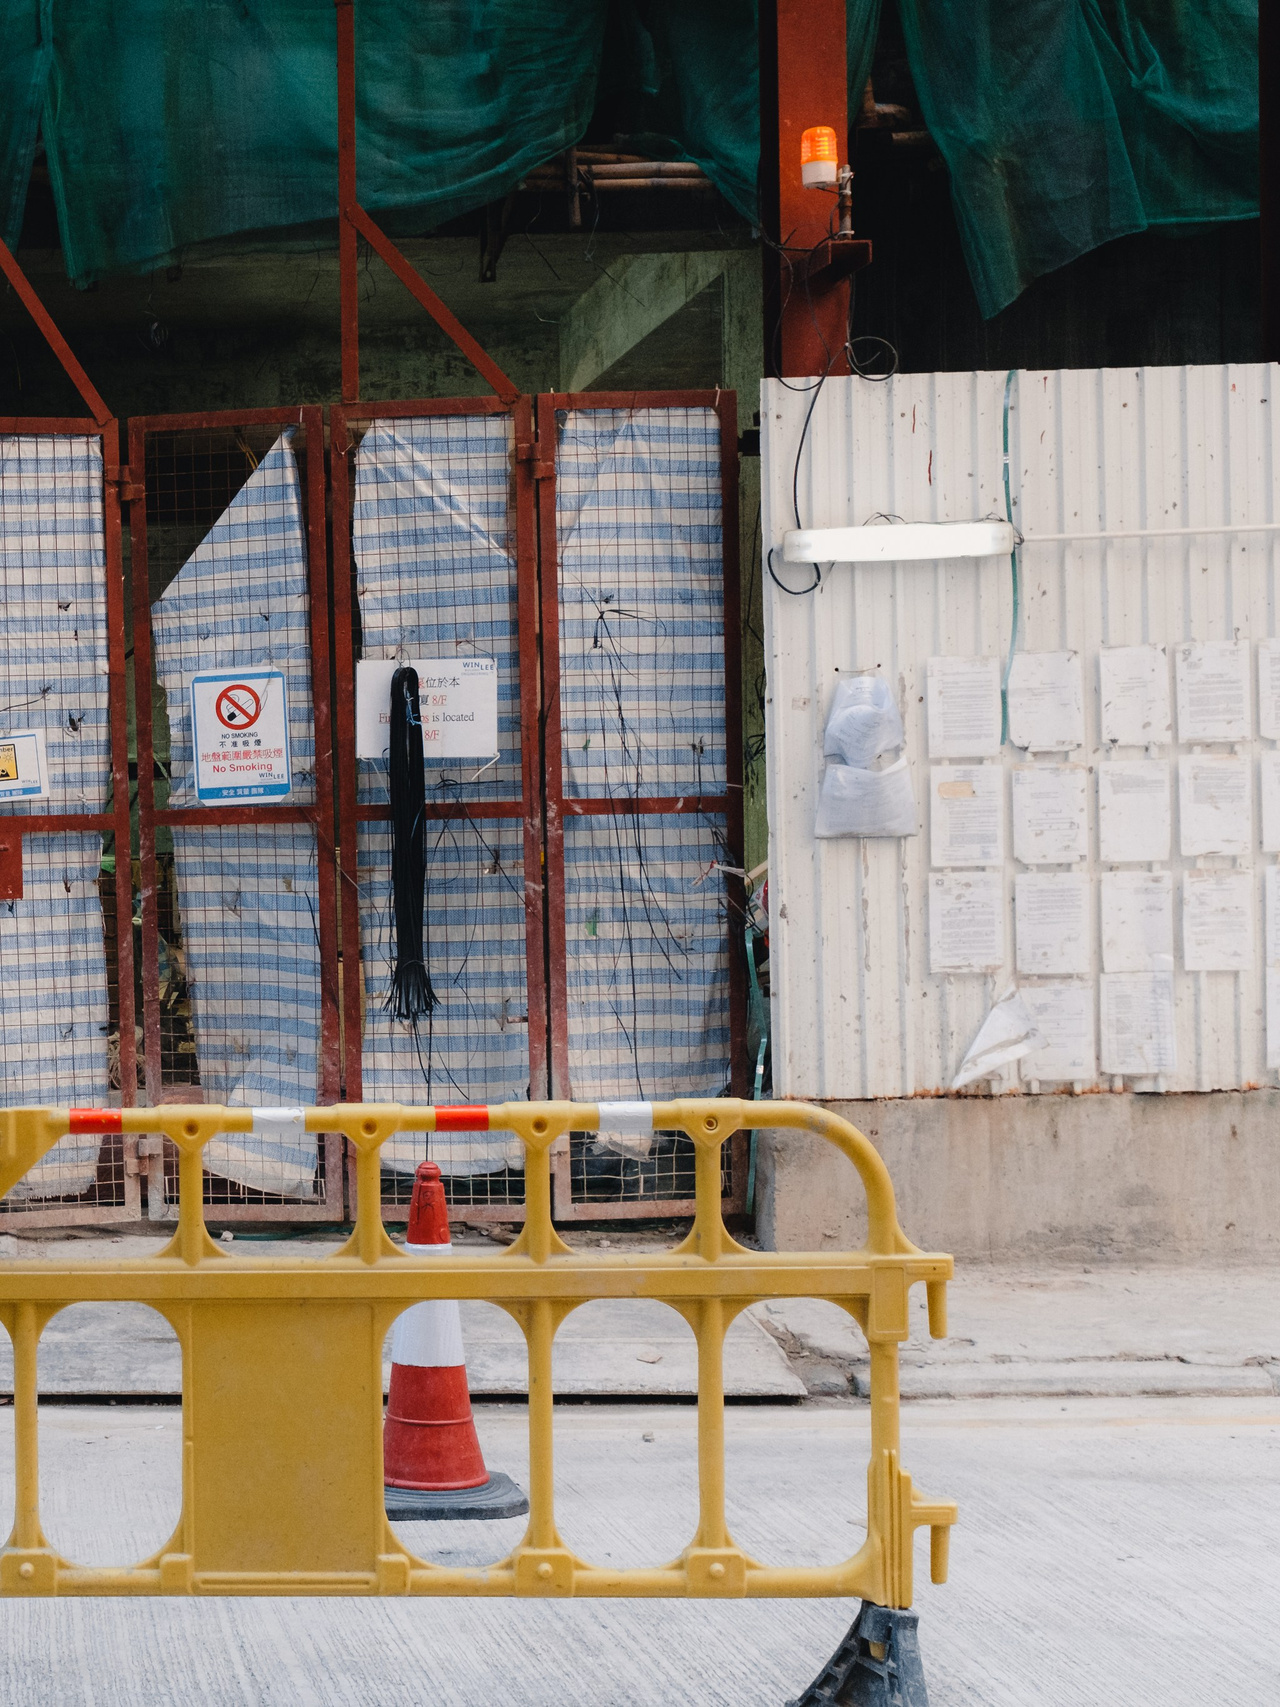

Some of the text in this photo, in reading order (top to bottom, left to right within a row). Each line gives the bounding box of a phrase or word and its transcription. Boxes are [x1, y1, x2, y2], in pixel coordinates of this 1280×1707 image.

[432, 695, 447, 706] 8/F
[432, 713, 440, 722] is
[442, 712, 475, 722] located
[424, 730, 440, 741] 8/F
[212, 762, 273, 773] No Smoking
